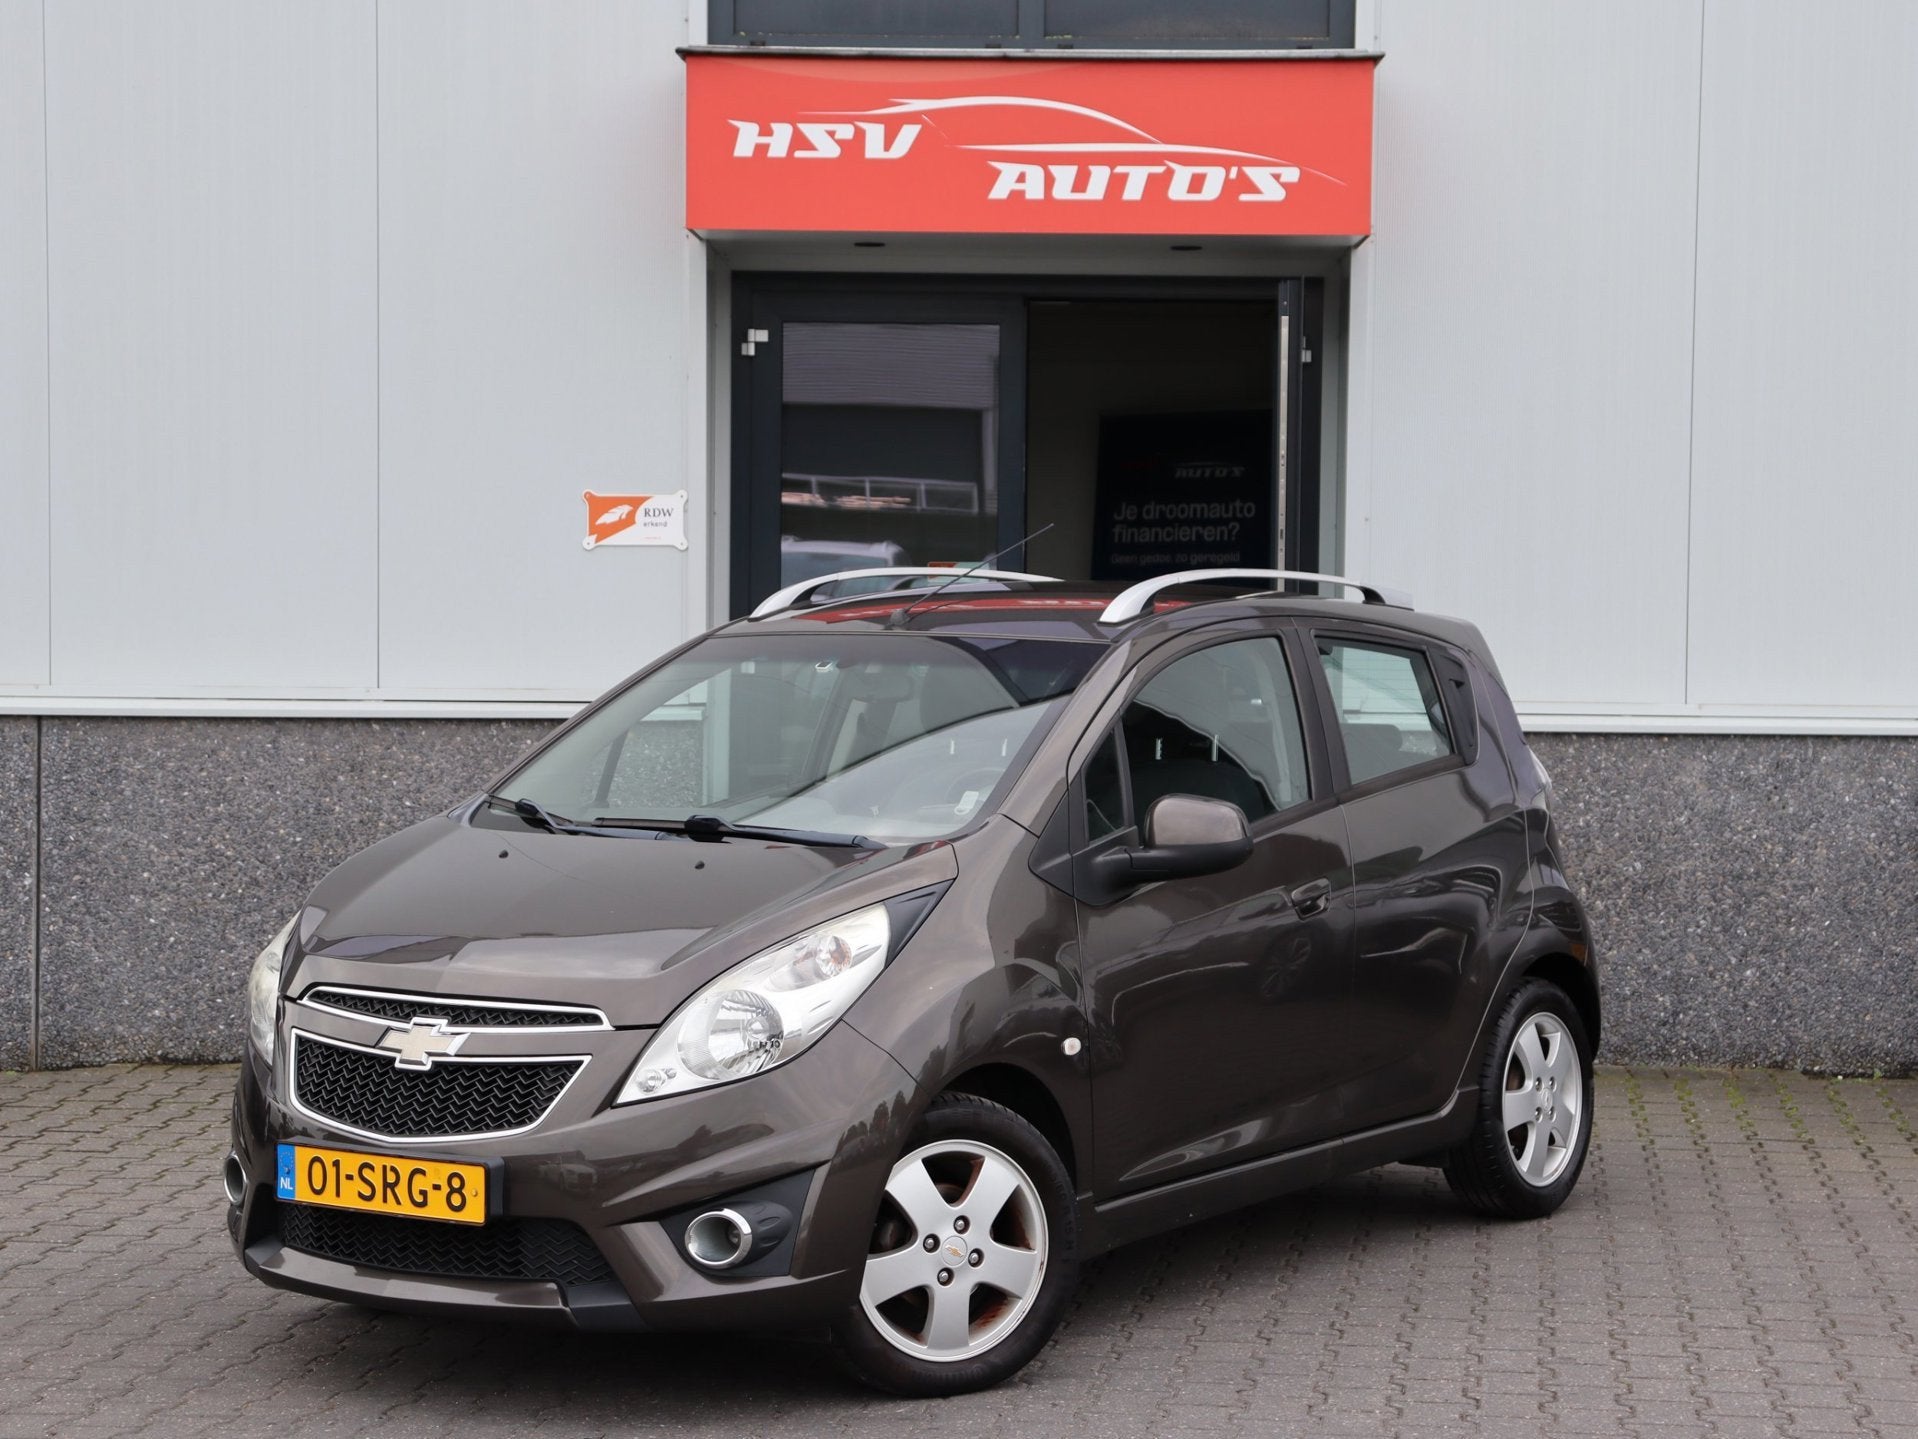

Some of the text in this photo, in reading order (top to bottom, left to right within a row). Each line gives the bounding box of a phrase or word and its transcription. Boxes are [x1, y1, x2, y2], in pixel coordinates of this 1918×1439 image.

[726, 119, 921, 158] HSV
[986, 160, 1300, 201] AUTO'S
[644, 507, 674, 517] RDW
[1113, 499, 1256, 520] Je droomauto
[1112, 522, 1240, 543] financieren?
[280, 1176, 293, 1190] NL
[307, 1155, 467, 1212] 01-SRG-8
